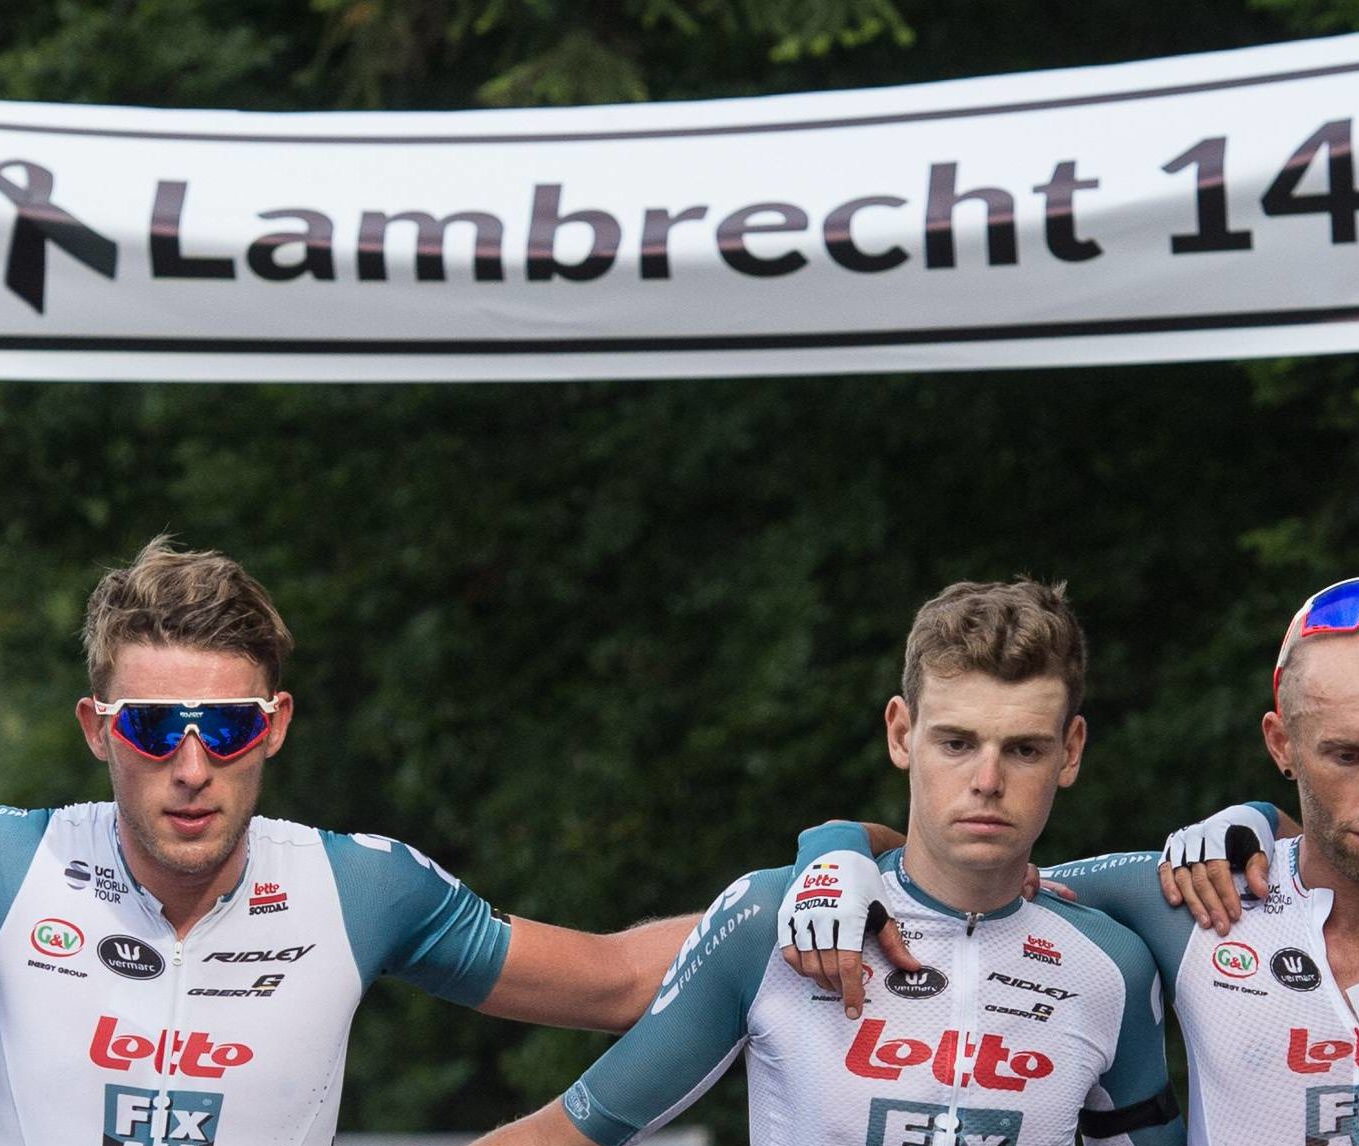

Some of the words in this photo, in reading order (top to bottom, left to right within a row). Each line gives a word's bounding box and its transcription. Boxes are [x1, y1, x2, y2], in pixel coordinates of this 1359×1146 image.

[148, 161, 1104, 285] Lambrecht
[95, 865, 115, 879] UCI
[1054, 868, 1086, 878] FUEL
[1092, 857, 1130, 873] CARD
[95, 878, 129, 894] WORLD
[94, 889, 121, 904] TOUR
[794, 898, 839, 913] SOUDAL
[249, 902, 288, 915] SOUDAL
[38, 925, 78, 950] G&V
[899, 930, 923, 940] RLD
[202, 943, 317, 963] RIDLEY
[678, 958, 703, 990] FUEL
[705, 919, 735, 956] CARD
[1217, 948, 1253, 970] G&V
[27, 959, 56, 972] ENERGY
[58, 967, 88, 979] GROUP
[108, 958, 156, 973] vermarc
[187, 988, 276, 998] GAERNE
[986, 972, 1079, 1000] RIDLEY
